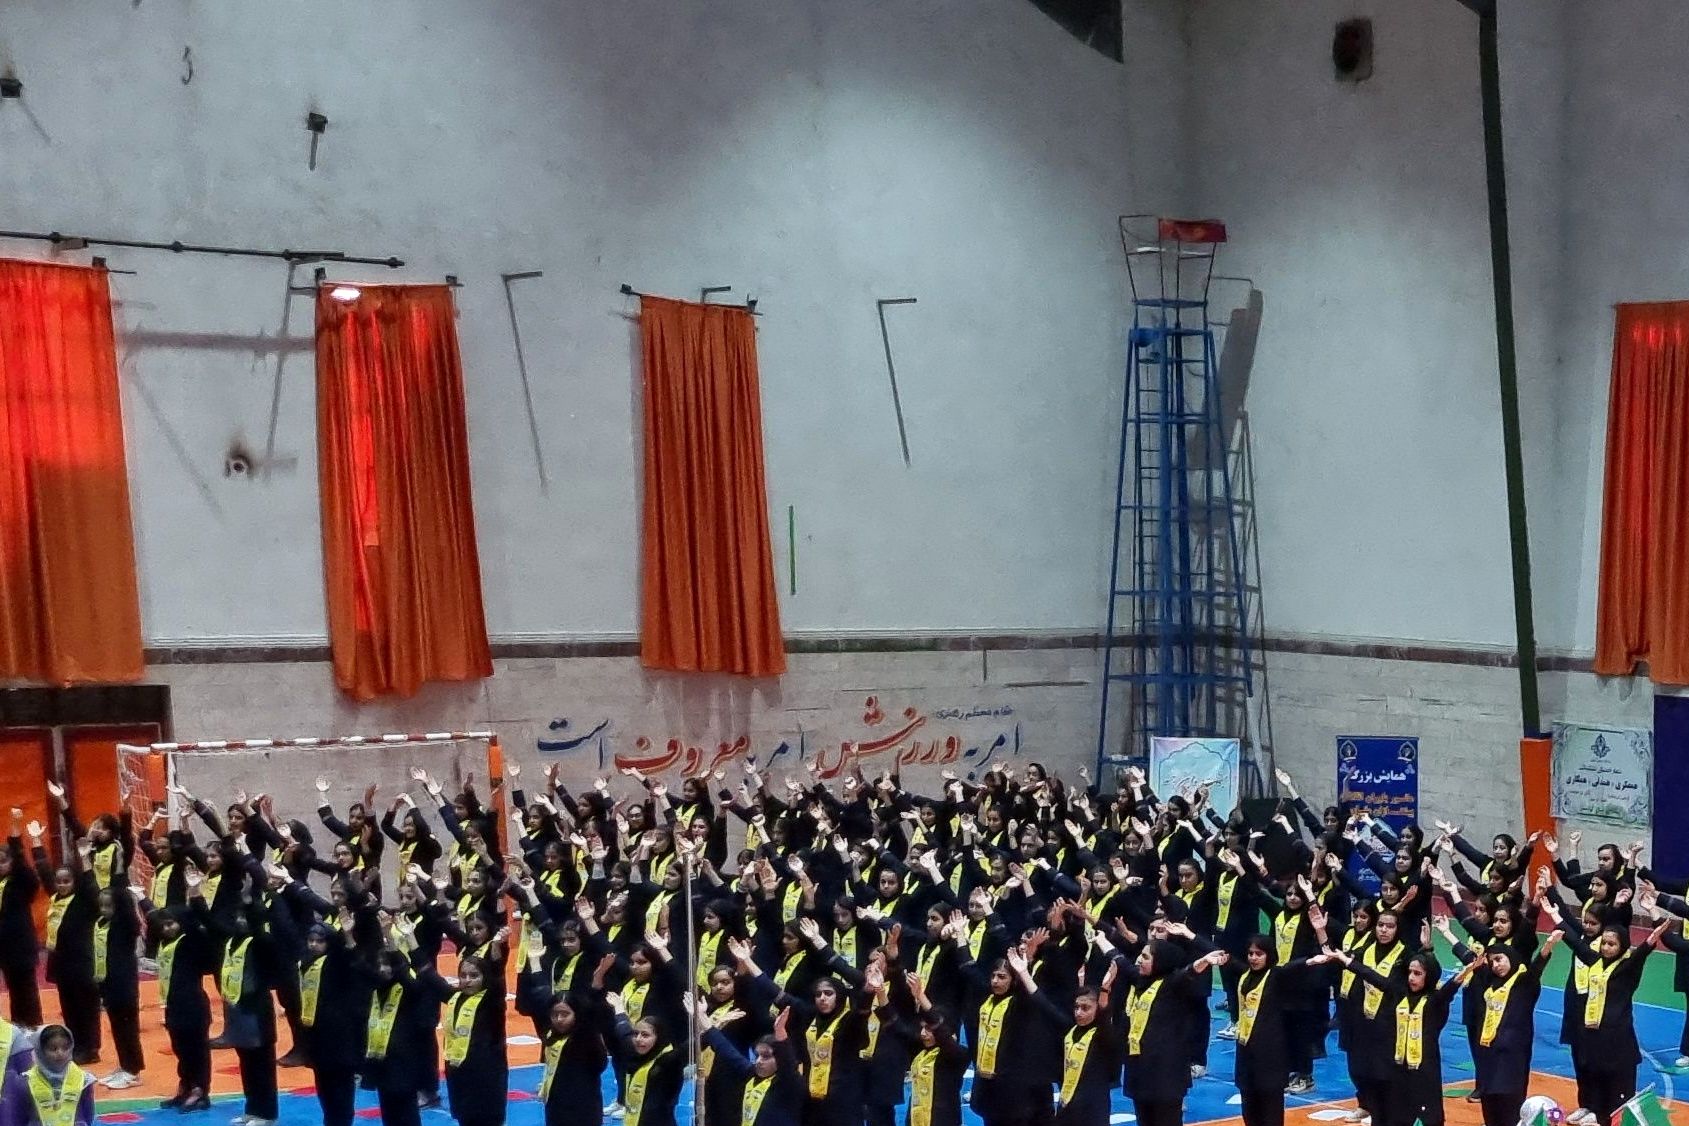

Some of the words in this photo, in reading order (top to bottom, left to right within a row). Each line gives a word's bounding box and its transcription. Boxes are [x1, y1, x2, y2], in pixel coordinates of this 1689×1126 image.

[537, 718, 609, 771] است
[614, 734, 750, 782] معروف
[816, 695, 962, 781] ورزش
[1350, 769, 1373, 784] بزرگ
[1374, 770, 1407, 784] همایش
